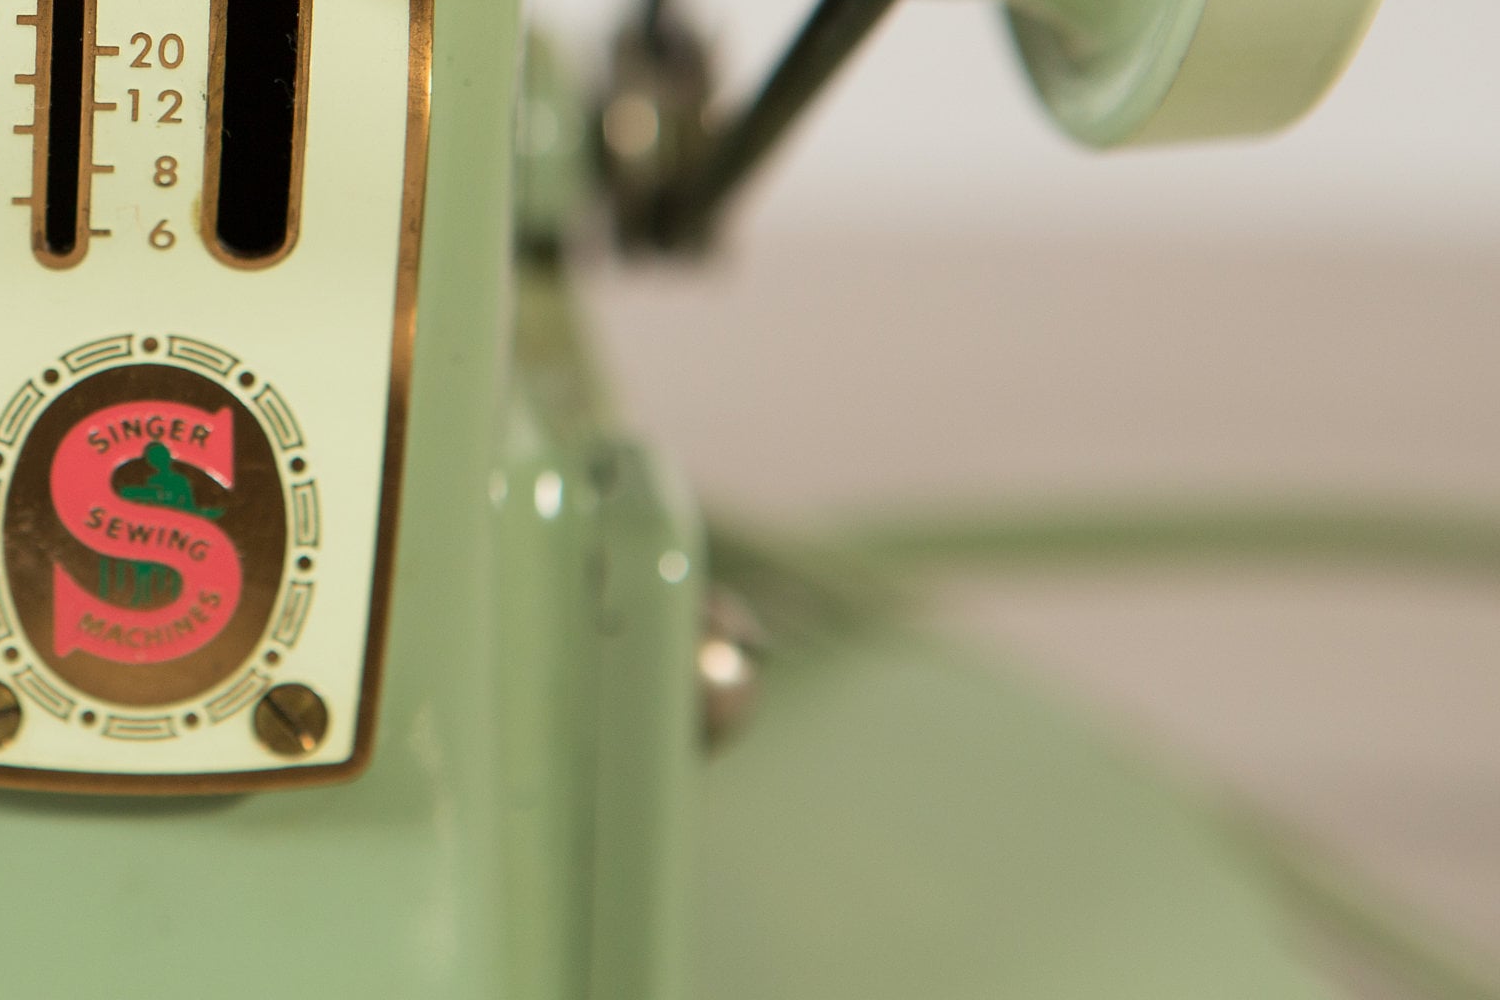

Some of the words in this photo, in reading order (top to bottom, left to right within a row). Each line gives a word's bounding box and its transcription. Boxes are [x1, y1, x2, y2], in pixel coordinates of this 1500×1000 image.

[129, 32, 184, 69] 20
[128, 89, 183, 124] 12
[153, 156, 178, 187] 8
[149, 220, 176, 250] 6
[87, 415, 212, 454] SINGER
[85, 507, 212, 562] SEWING
[78, 591, 221, 648] MACHINES
